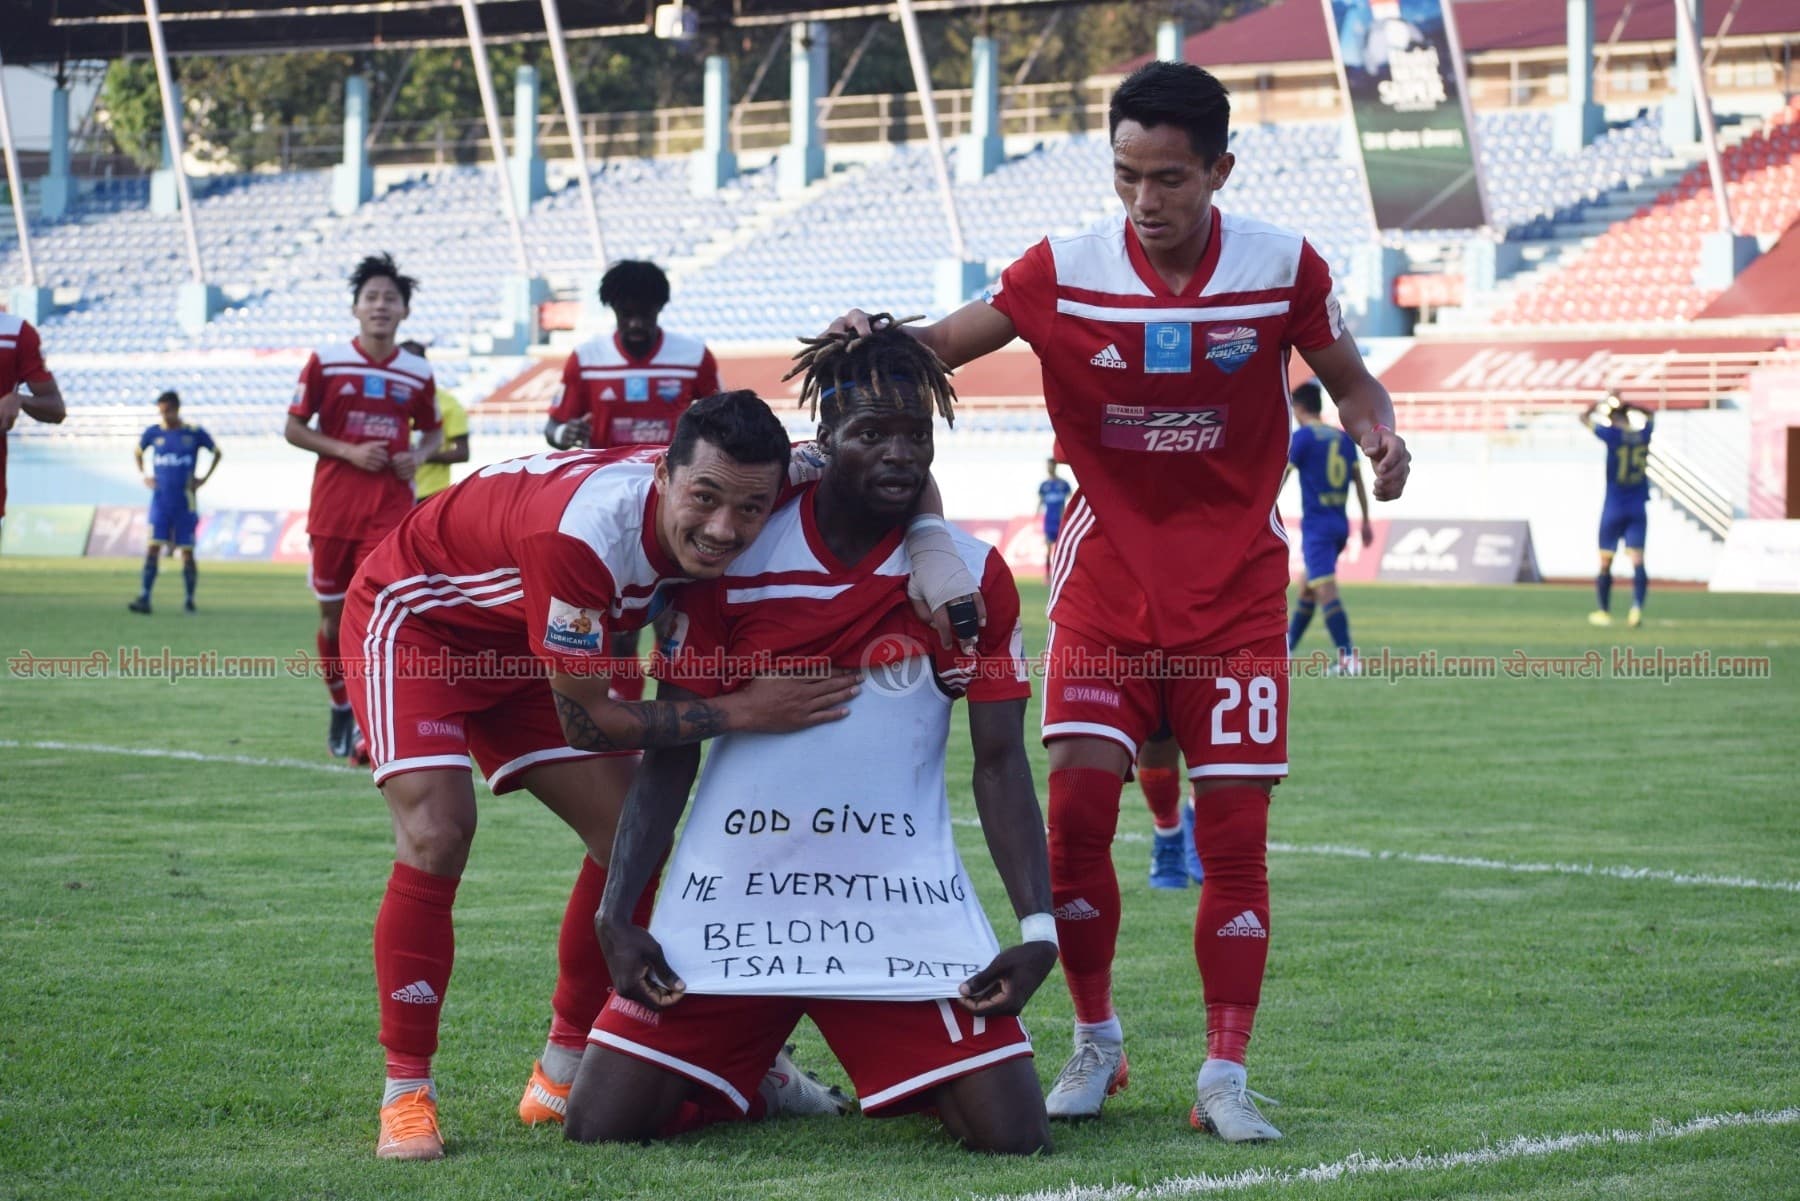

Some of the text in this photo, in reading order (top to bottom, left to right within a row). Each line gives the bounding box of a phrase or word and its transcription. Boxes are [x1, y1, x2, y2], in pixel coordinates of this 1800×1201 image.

[1090, 358, 1127, 369] adidas
[1117, 406, 1143, 415] YAMAHA
[1144, 411, 1217, 427] ZR
[1327, 439, 1347, 488] 6
[1076, 688, 1120, 706] YAMAHA
[1211, 676, 1277, 745] 28
[682, 872, 723, 902] ME
[1054, 909, 1100, 920] adidas
[704, 920, 875, 951] BELOMO
[1216, 927, 1267, 938] adidas
[712, 956, 845, 978] TSALA
[391, 991, 438, 1004] adidas
[620, 996, 660, 1025] YAMAHA
